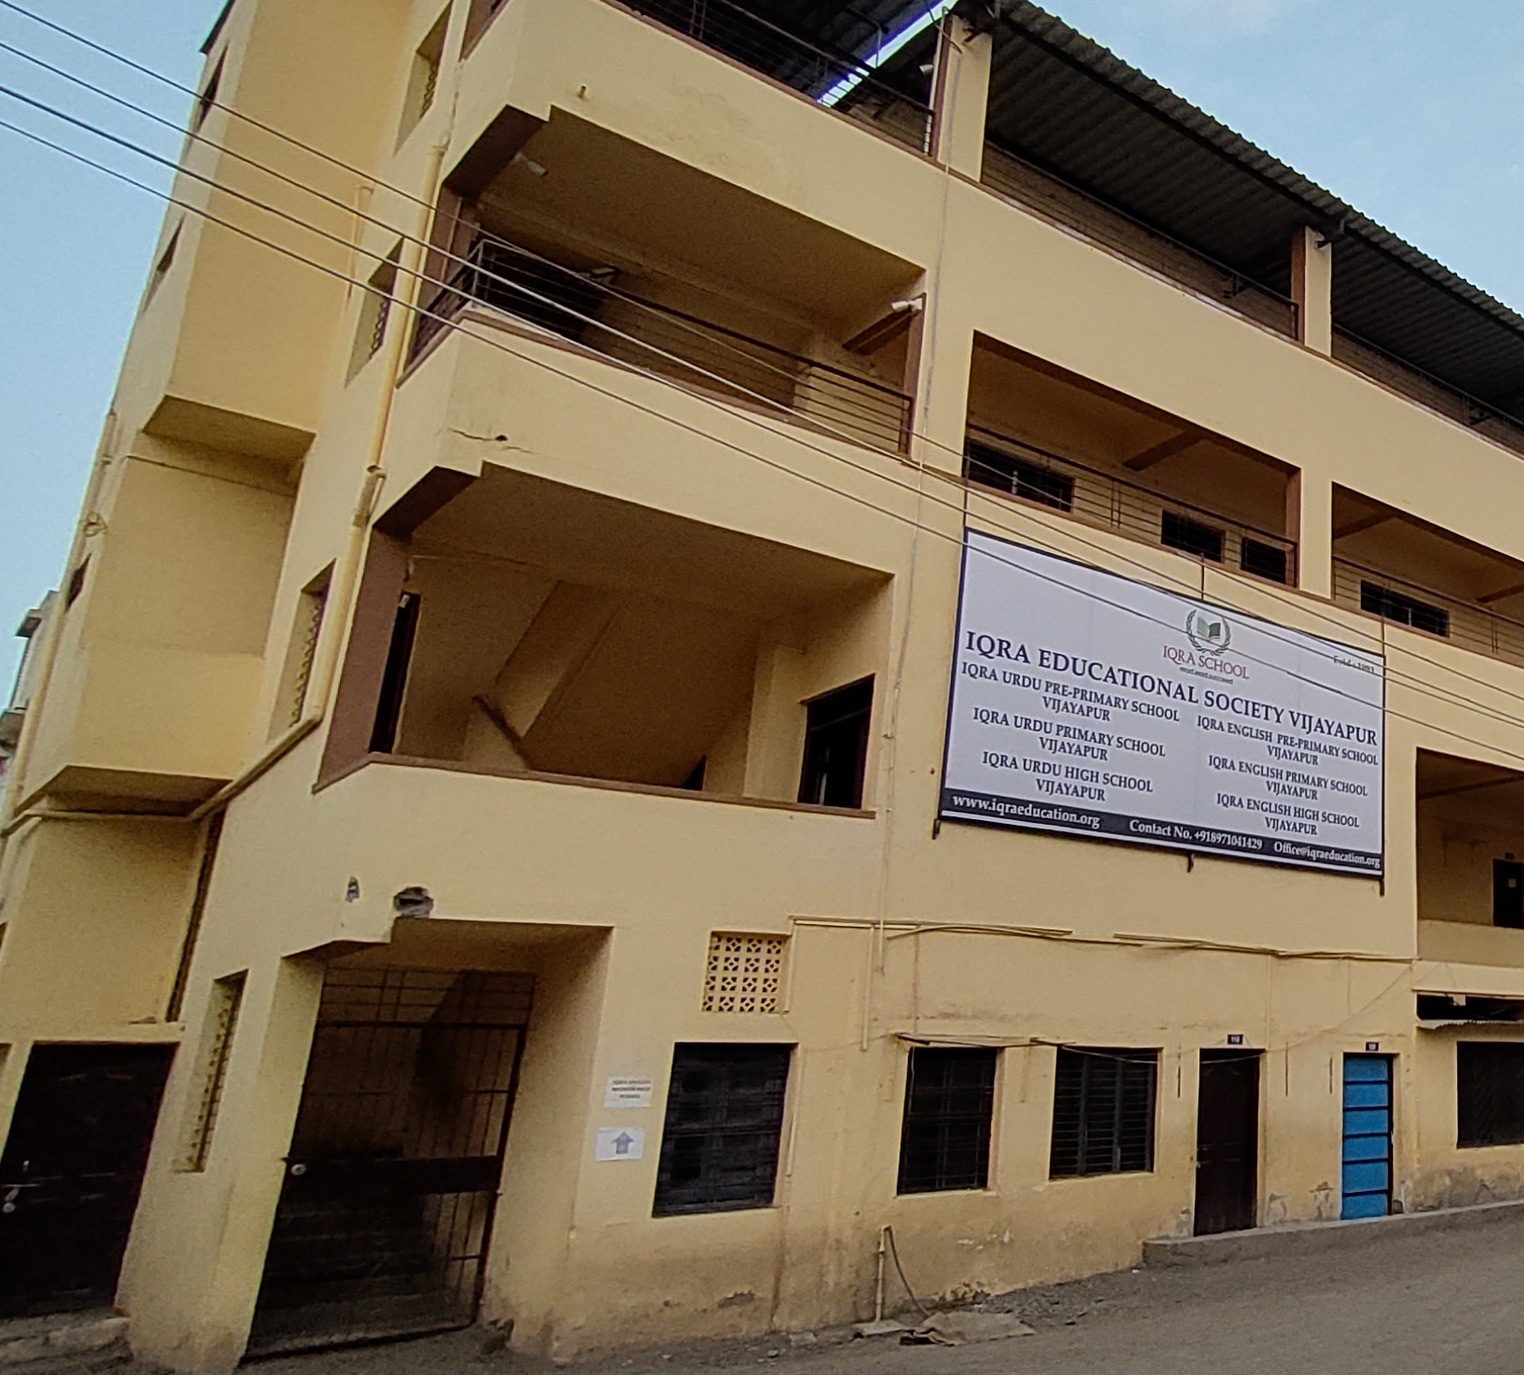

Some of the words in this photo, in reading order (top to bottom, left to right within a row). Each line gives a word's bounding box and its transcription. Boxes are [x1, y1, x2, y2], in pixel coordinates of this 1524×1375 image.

[1163, 645, 1195, 665] IQRA
[1198, 655, 1250, 679] SCHOOL
[961, 661, 998, 681] IQRA
[1002, 670, 1042, 691] URDU
[1045, 681, 1129, 711] PRE-PRIMARY
[1131, 700, 1180, 722] SCHOOL
[965, 631, 1031, 664] IQRA
[1038, 648, 1199, 704] EDUCATIONAL
[1204, 690, 1284, 724] SOCIETY
[1289, 710, 1378, 746] VIJAYAPUR
[1042, 696, 1111, 722] VIJAYAPUR
[973, 707, 1010, 727] IQRA
[1014, 715, 1053, 735] URDU
[1055, 724, 1114, 747] PRIMARY
[1116, 736, 1166, 757] SCHOOL
[1039, 737, 1108, 761] VIJAYAPUR
[1197, 715, 1225, 732] IQRA
[1227, 722, 1273, 743] ENGLISH
[1277, 733, 1341, 758] PRE-PRIMARY
[1342, 748, 1379, 766] SCHOOL
[982, 751, 1018, 770] IQRA
[1023, 758, 1062, 776] URDU
[1064, 766, 1099, 784] HIGH
[1102, 773, 1153, 793] SCHOOL
[1267, 745, 1319, 766] VIJAYAPUR
[1036, 779, 1106, 802] VIJAYAPUR
[1208, 755, 1236, 771] IQRA
[1238, 761, 1283, 780] ENGLISH
[1285, 770, 1329, 789] PRIMARY
[1330, 780, 1368, 797] SCHOOL
[1266, 781, 1318, 801] VIJAYAPUR
[953, 794, 1101, 829] www.iqraeducation.org
[1217, 793, 1244, 809] IQRA
[1246, 799, 1291, 816] ENGLISH
[1293, 806, 1319, 821] HIGH
[1321, 812, 1360, 828] SCHOOL
[1265, 817, 1318, 835] VIJAYAPUR
[1129, 819, 1171, 836] Contact
[1174, 825, 1193, 840] No.
[1274, 841, 1381, 869] Office@iqraeducation.org
